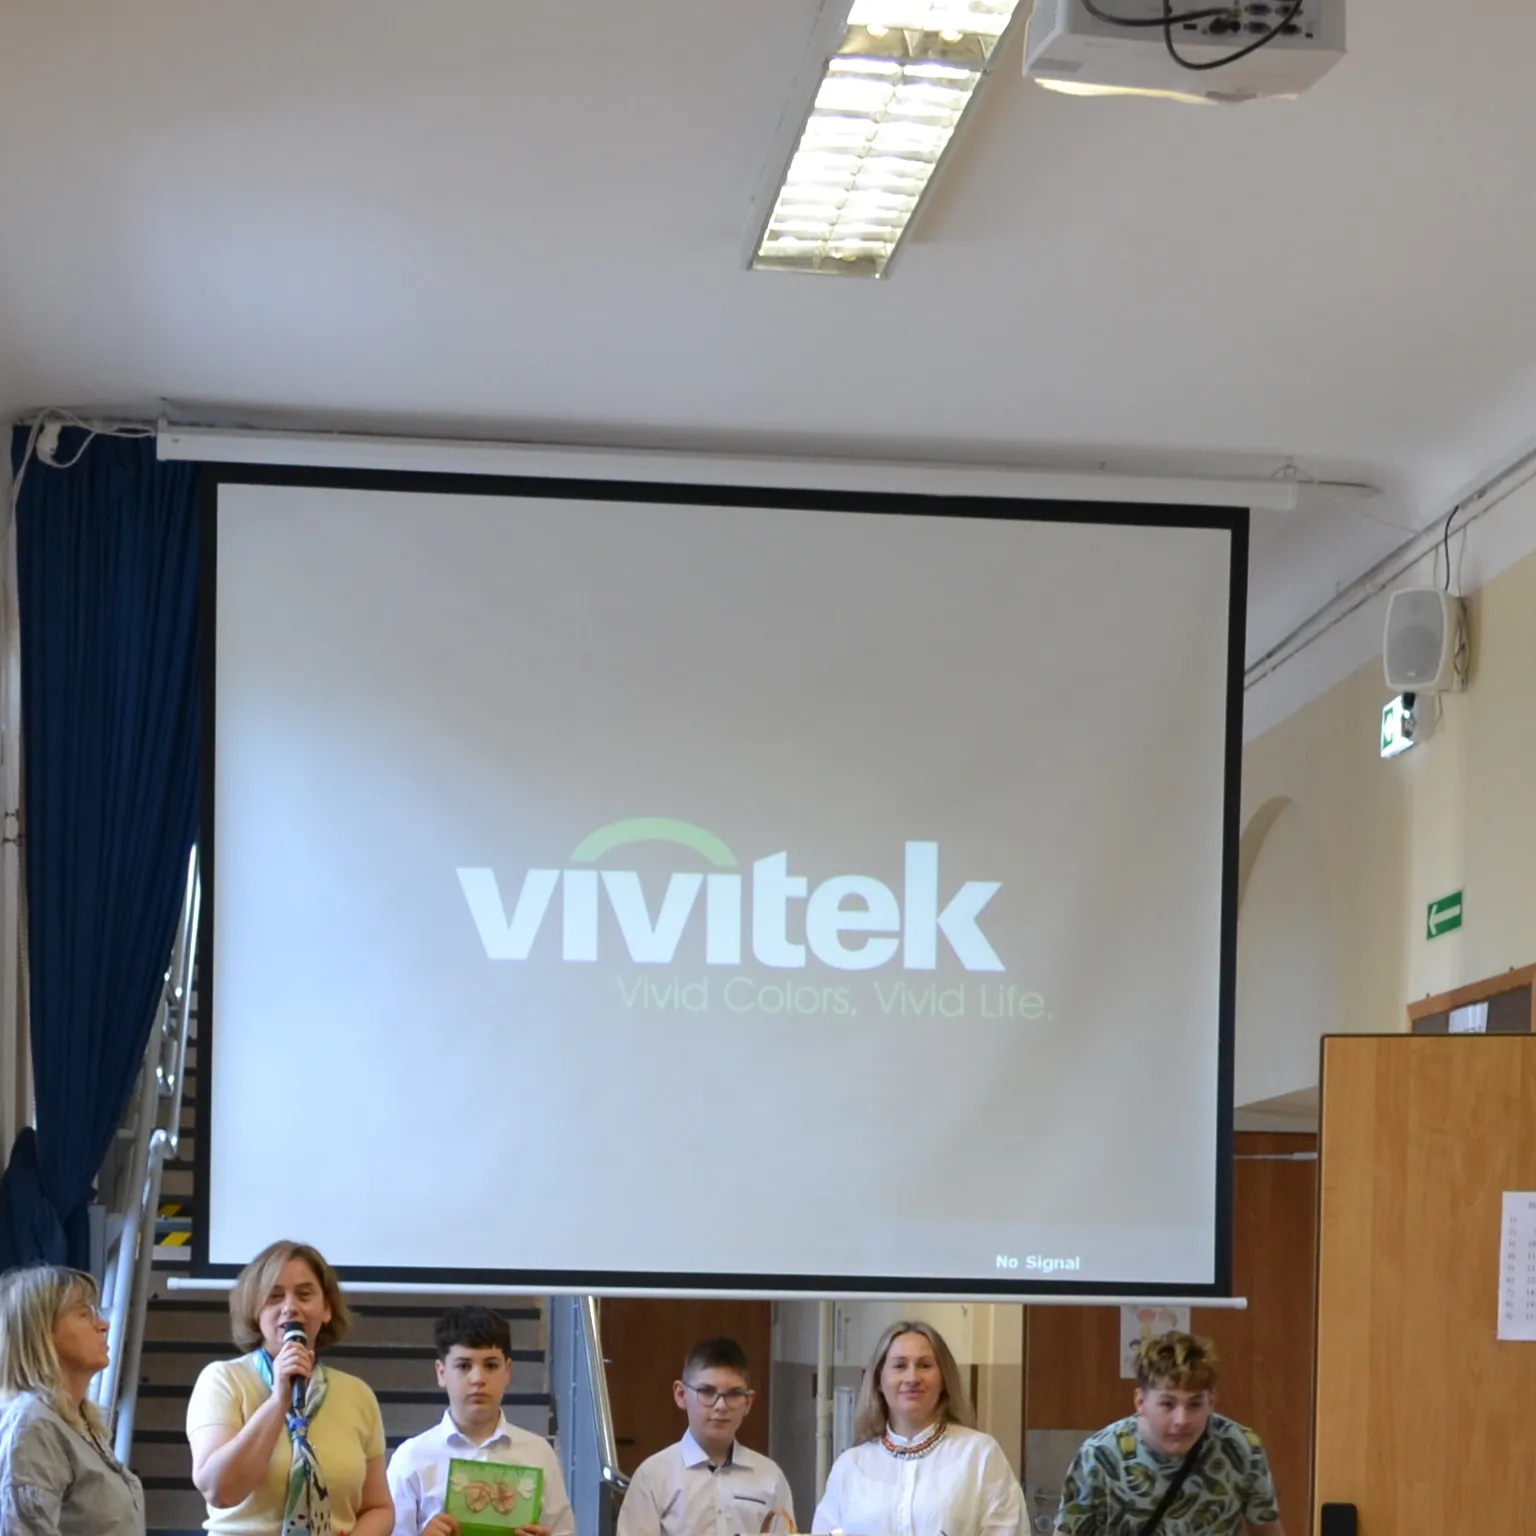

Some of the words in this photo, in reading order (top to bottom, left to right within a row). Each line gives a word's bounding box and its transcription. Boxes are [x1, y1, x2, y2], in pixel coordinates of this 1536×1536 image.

[455, 838, 1007, 973] vivitek
[615, 973, 709, 1012] Vivid
[723, 976, 857, 1017] Colors,
[873, 980, 965, 1017] Vivid
[980, 983, 1053, 1020] Life.
[995, 1254, 1019, 1269] No
[1025, 1254, 1081, 1273] Signal
